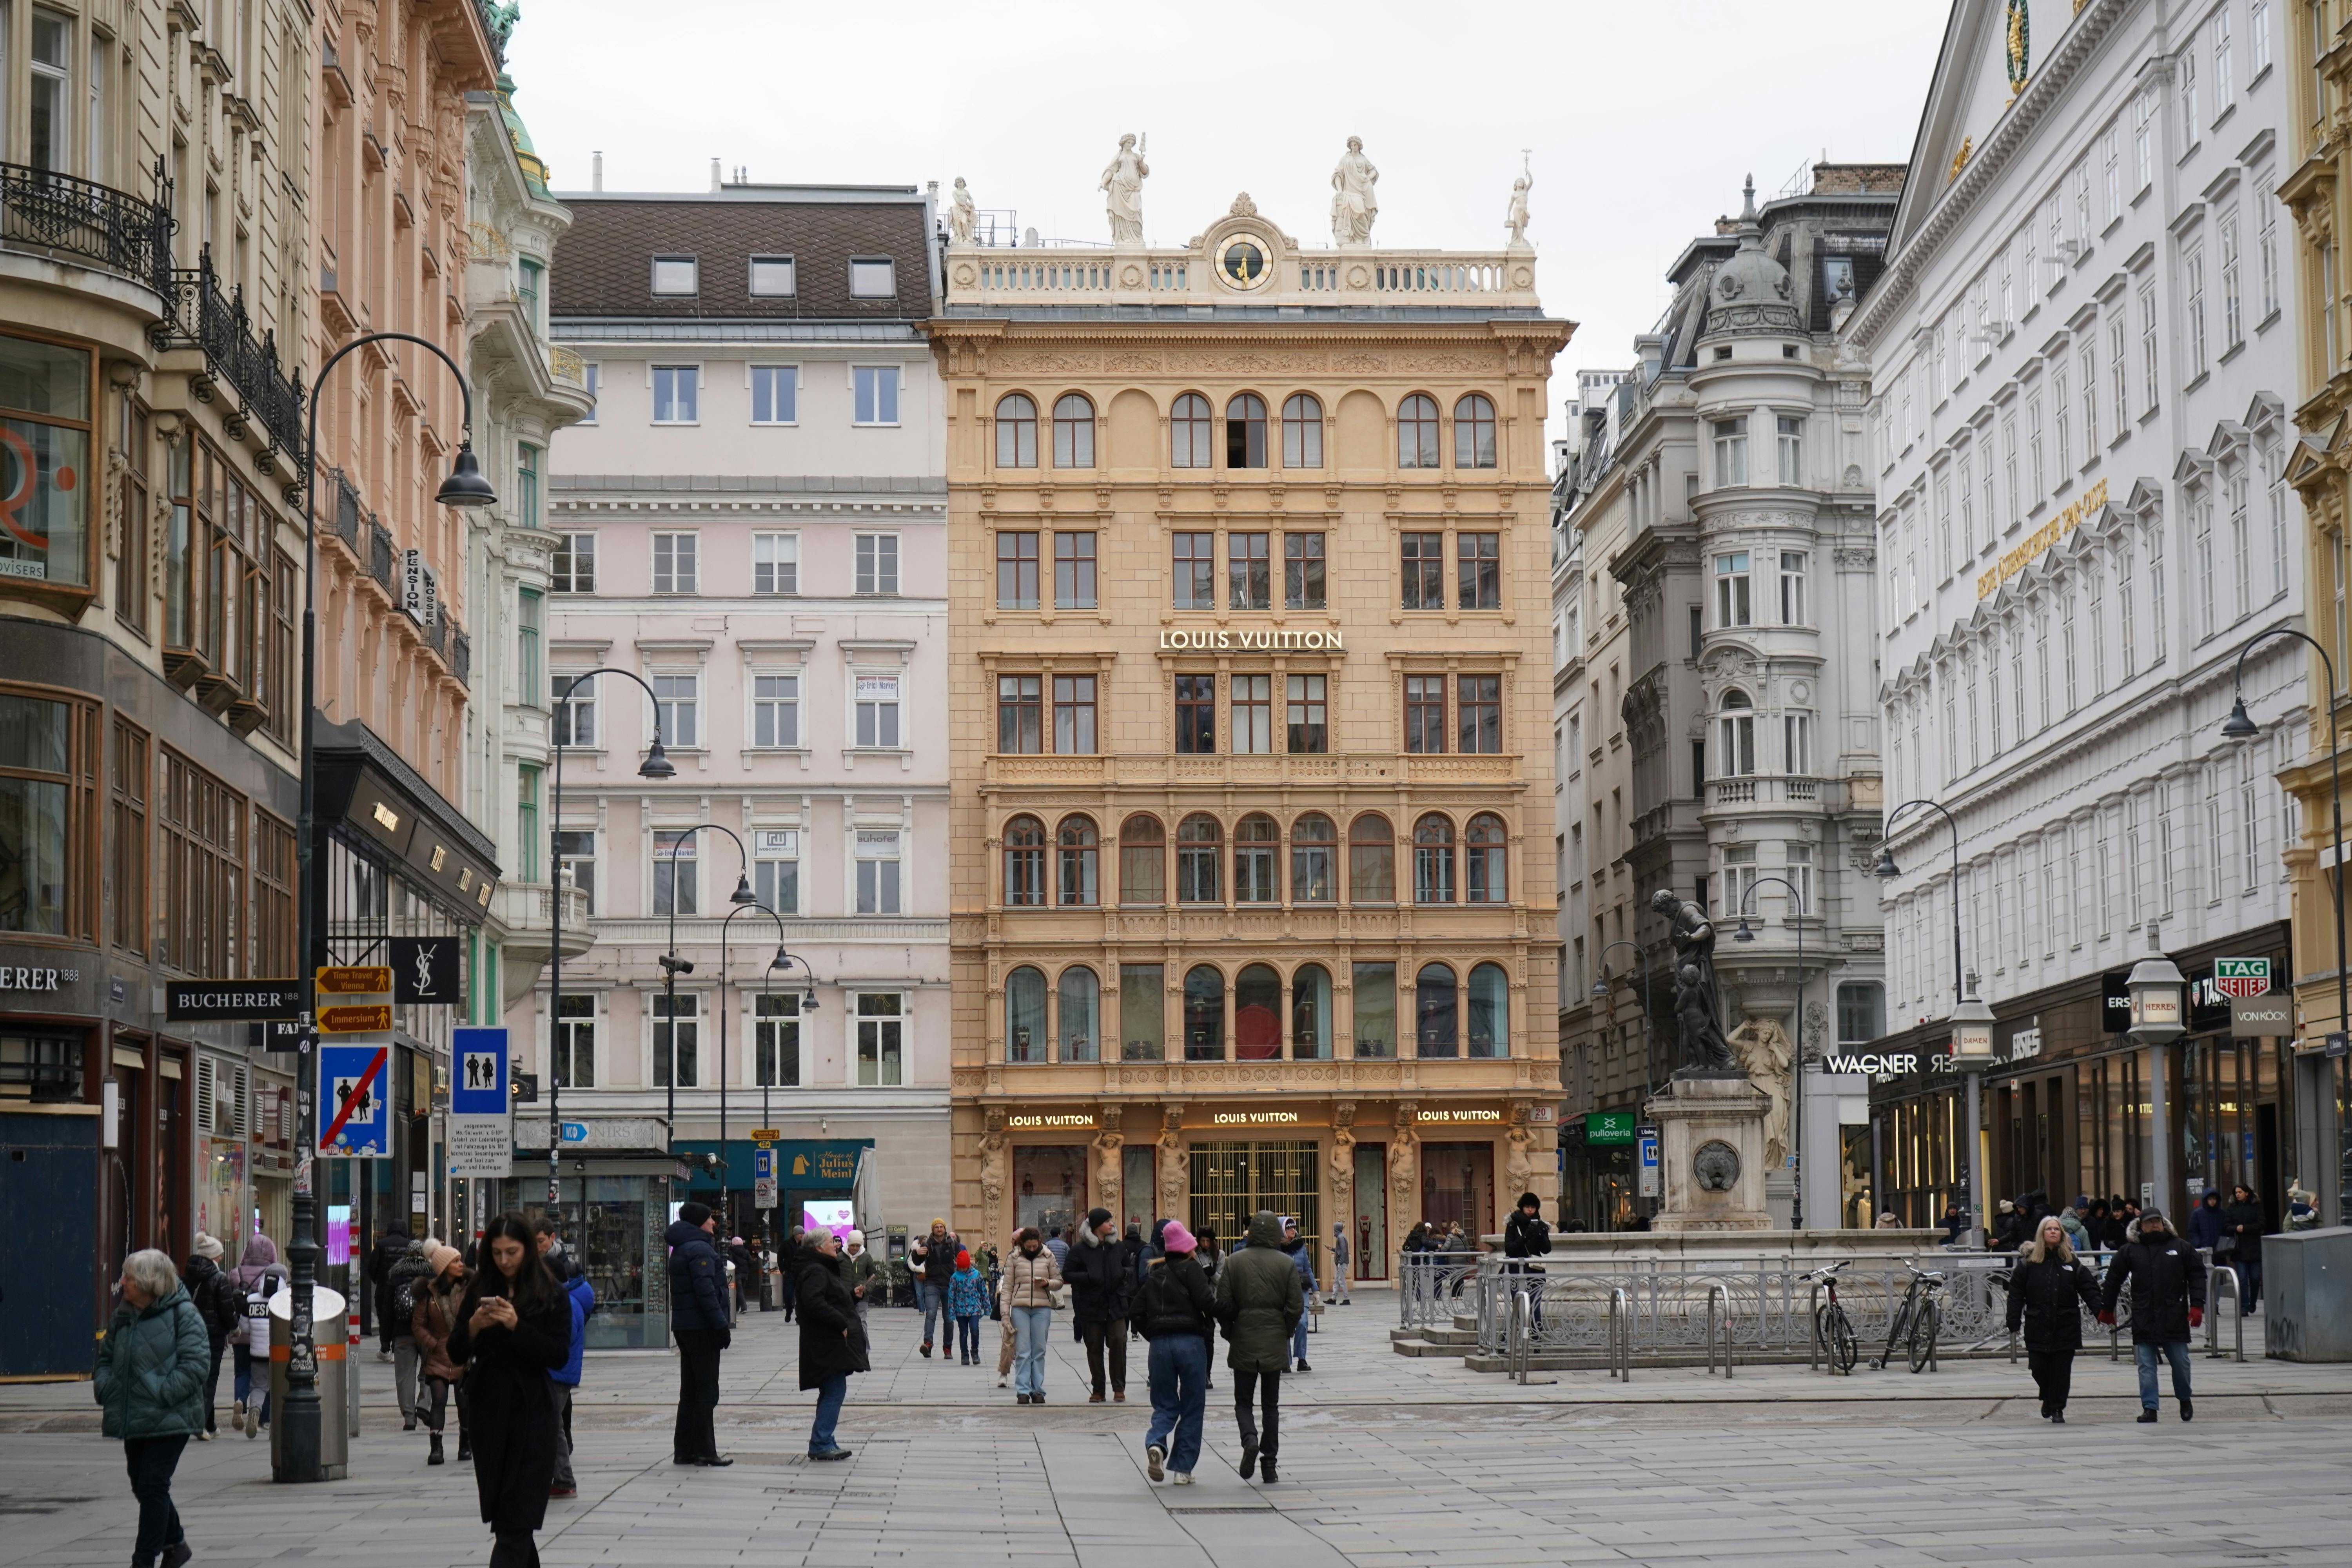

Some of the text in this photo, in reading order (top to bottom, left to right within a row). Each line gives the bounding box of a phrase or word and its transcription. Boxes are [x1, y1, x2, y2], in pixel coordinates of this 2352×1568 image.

[407, 550, 419, 608] PENSION
[426, 581, 435, 625] NOSSEK
[1160, 631, 1342, 649] LOUIS VUITTON
[2221, 962, 2264, 975] TAG
[61, 969, 78, 981] 1888
[178, 993, 282, 1008] BUCHERER
[332, 1014, 374, 1024] Immersium
[2238, 1009, 2287, 1021] VON KÖCK
[1826, 1054, 1918, 1074] WAGNER
[1009, 1115, 1093, 1126] LOUIS VUITTON
[1215, 1112, 1298, 1123] LOUIS VUITTON
[1417, 1111, 1500, 1120] LOUIS VUITTON
[1590, 1129, 1631, 1138] pulloveria
[847, 1151, 854, 1161] of
[819, 1158, 854, 1168] Julius
[822, 1169, 851, 1178] Meinl
